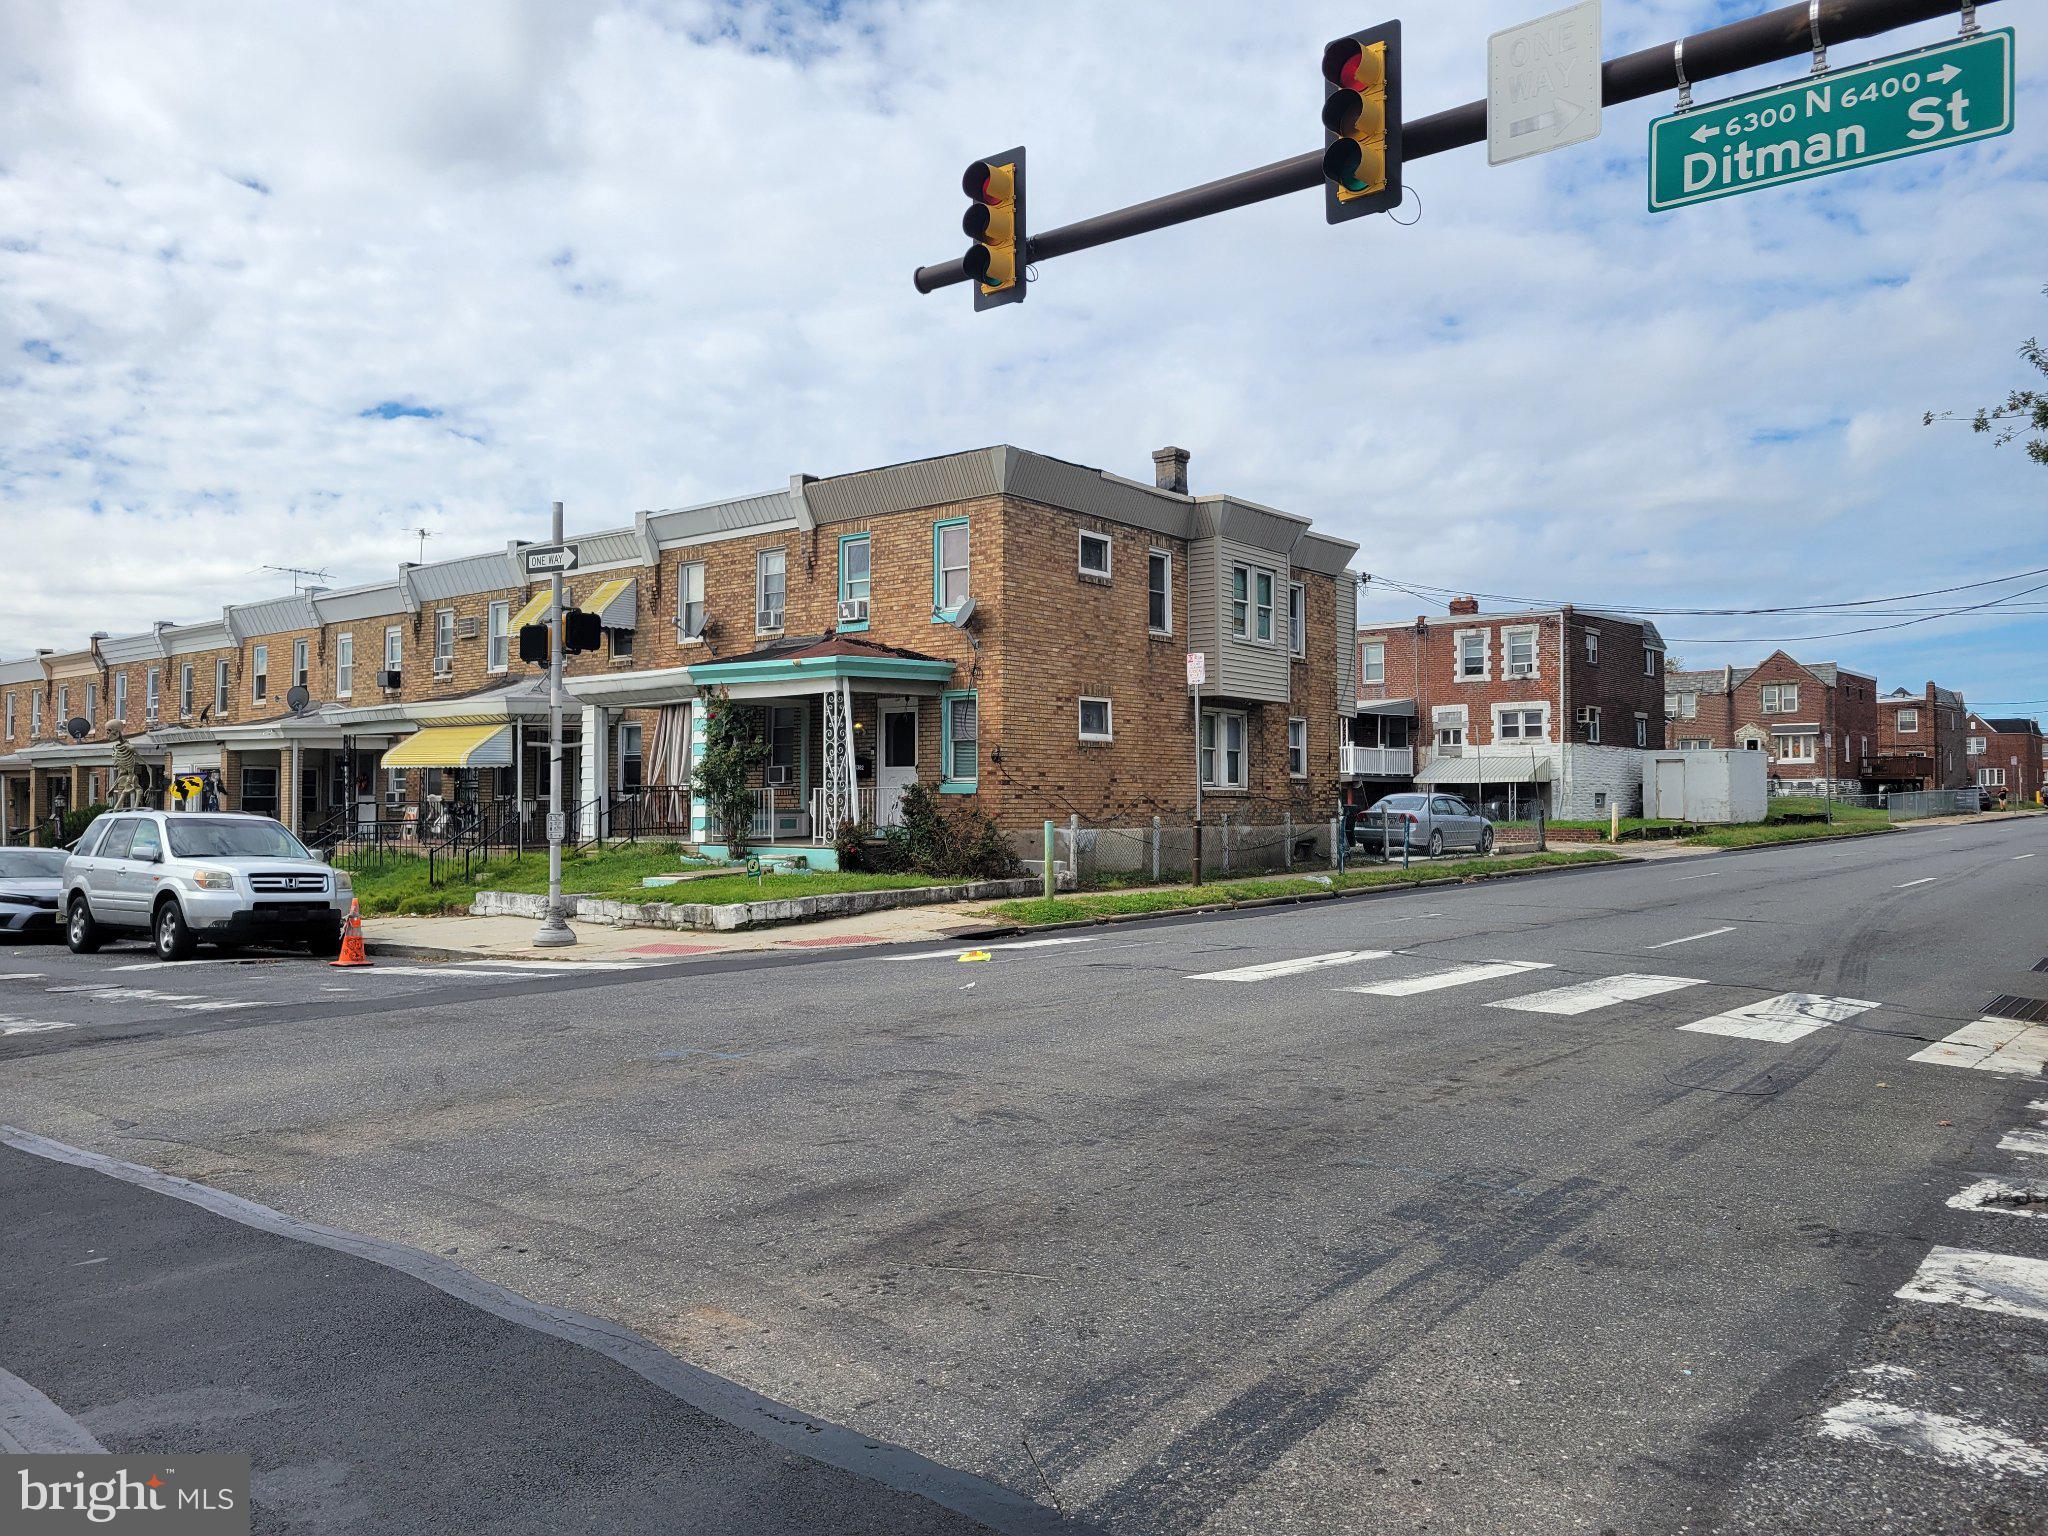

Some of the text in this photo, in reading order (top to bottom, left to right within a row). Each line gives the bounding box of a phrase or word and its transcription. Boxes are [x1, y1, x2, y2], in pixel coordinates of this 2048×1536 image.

[1511, 20, 1577, 68] ONE
[1507, 56, 1579, 104] WAY
[1725, 72, 1921, 137] 6300 N 6400
[1683, 88, 1970, 193] Ditman St
[531, 553, 563, 567] ONE WAY
